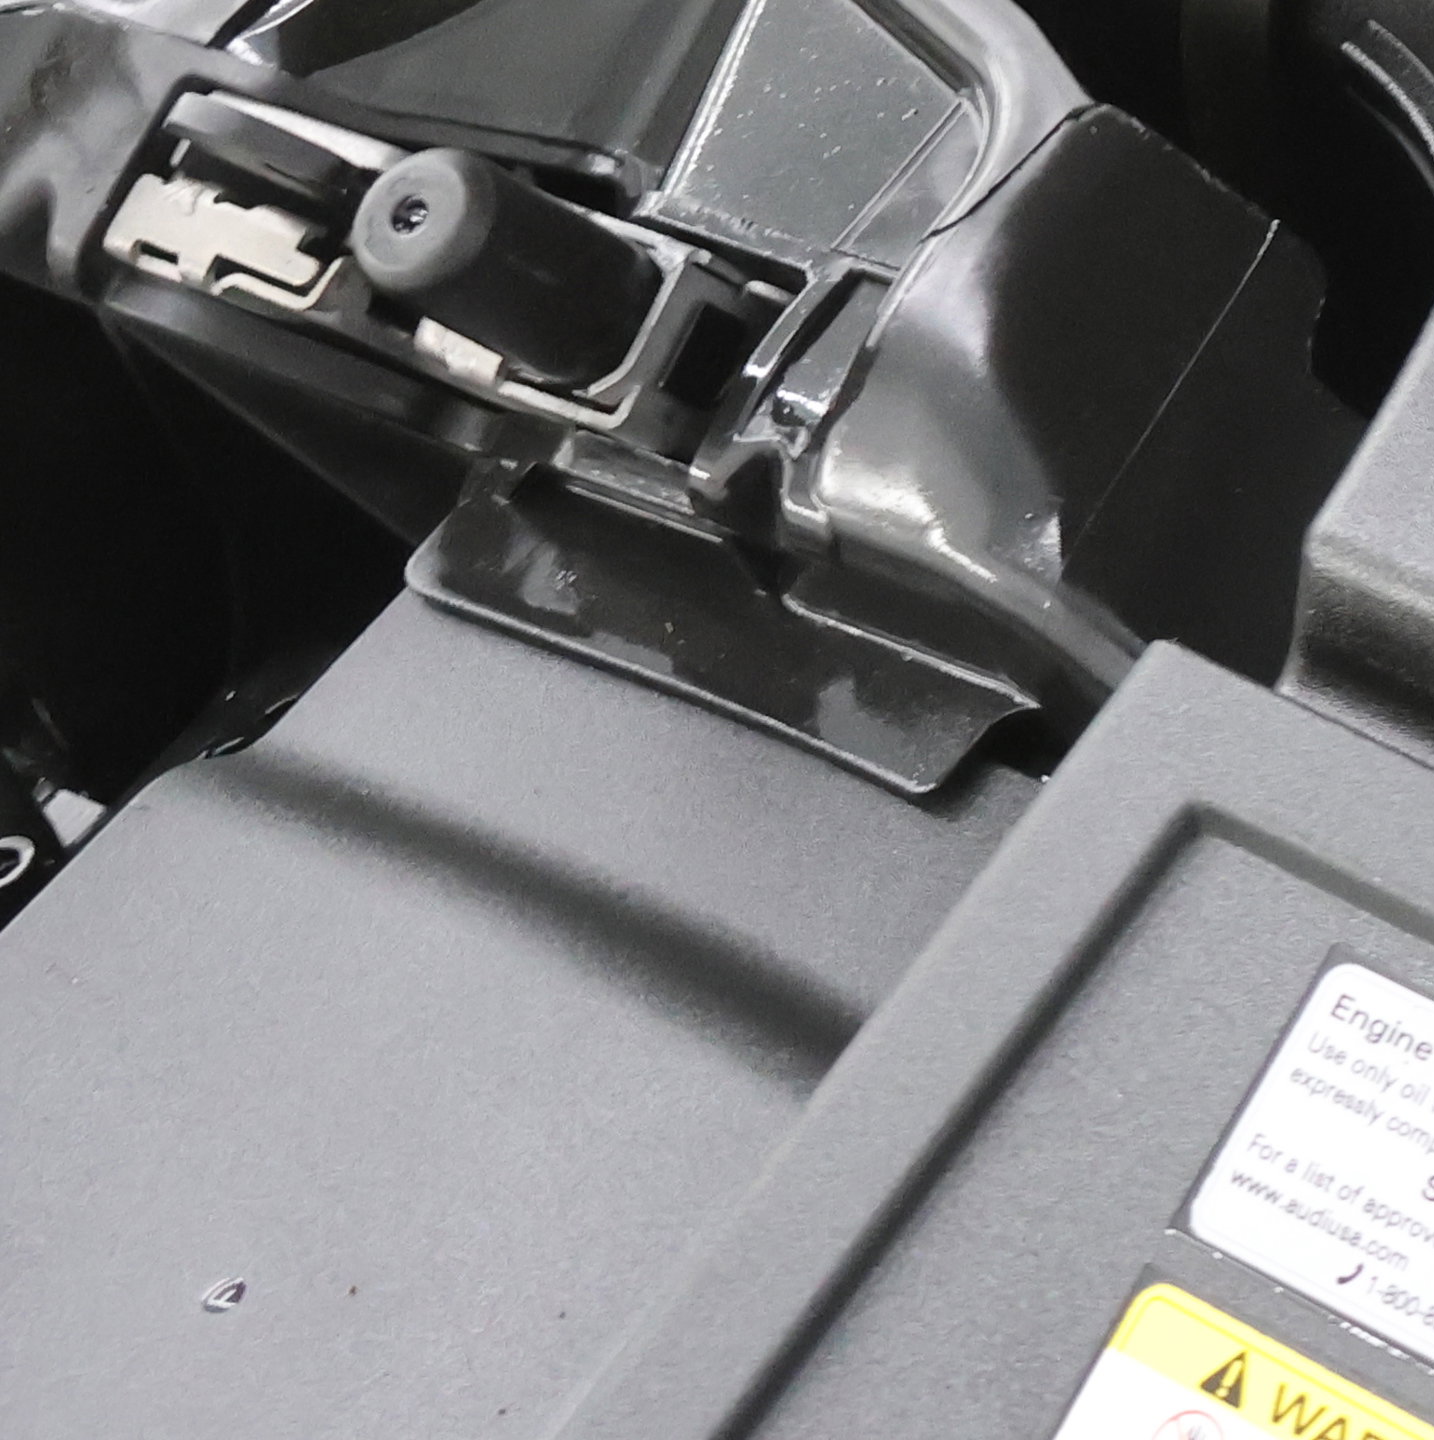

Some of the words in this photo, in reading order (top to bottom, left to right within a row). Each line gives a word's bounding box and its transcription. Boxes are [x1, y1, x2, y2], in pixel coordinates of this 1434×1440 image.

[1329, 993, 1434, 1062] Engine
[1290, 1068, 1384, 1126] expressly
[1308, 1033, 1347, 1066] Use
[1351, 1059, 1398, 1093] only
[1400, 1083, 1431, 1105] oil
[1247, 1133, 1283, 1163] For
[1284, 1158, 1298, 1174] a
[1302, 1162, 1335, 1192] list
[1337, 1184, 1365, 1204] of
[1230, 1170, 1409, 1270] www.audiusa.com
[1272, 1384, 1385, 1440] WA
